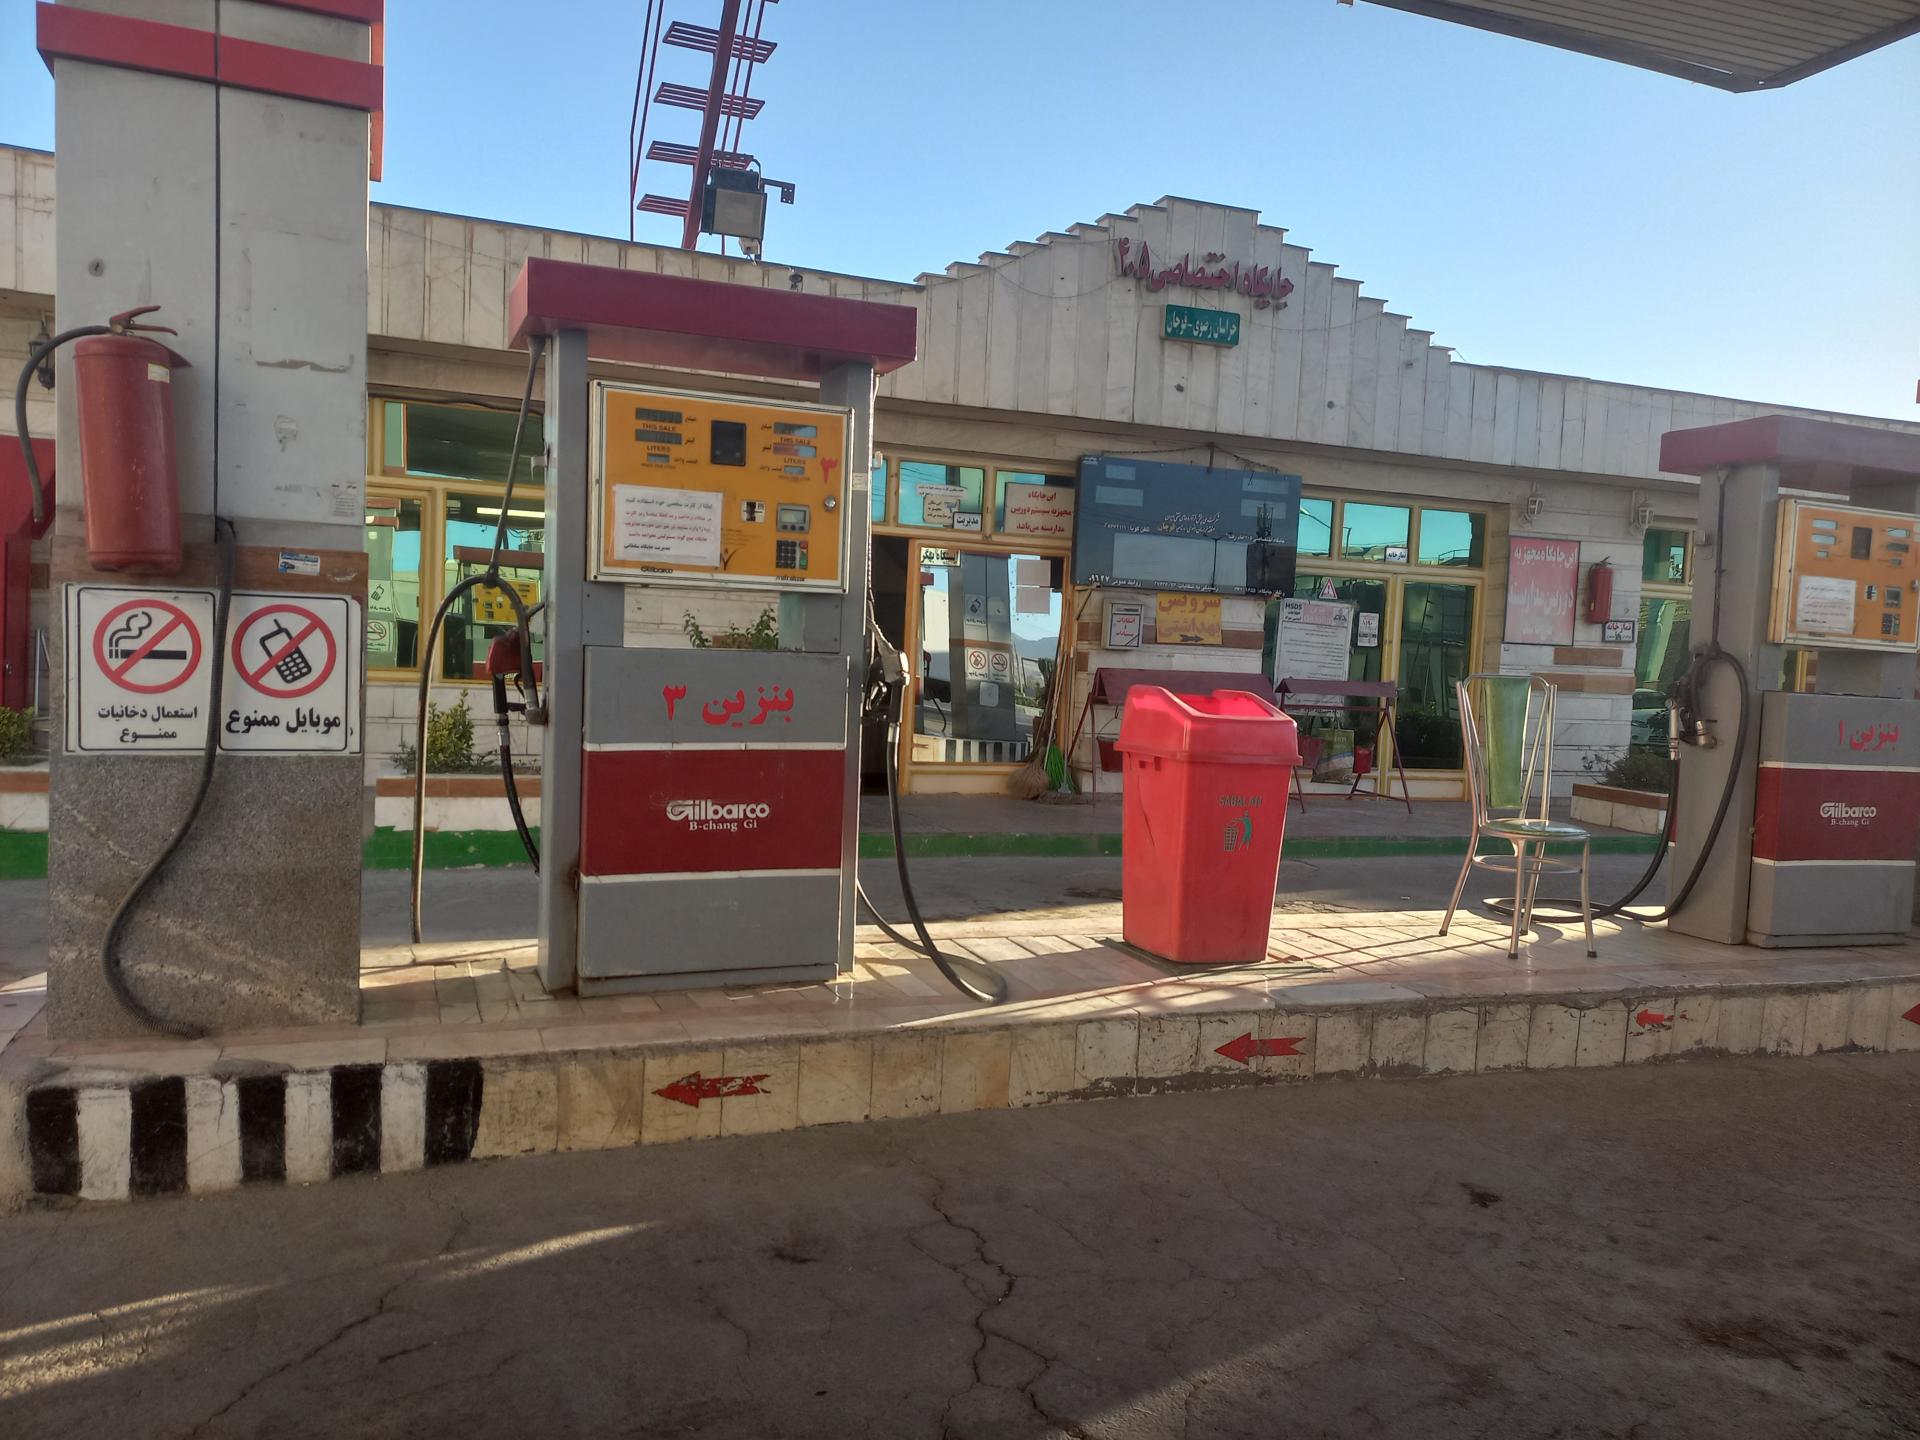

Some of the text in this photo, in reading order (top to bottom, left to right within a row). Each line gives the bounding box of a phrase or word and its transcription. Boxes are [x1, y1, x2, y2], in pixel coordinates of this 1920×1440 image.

[1241, 263, 1295, 310] جایگاه
[1166, 310, 1188, 336] قوچان
[1191, 318, 1213, 339] رضوی
[1212, 315, 1237, 342] خراسان
[1028, 490, 1057, 502] این جایگاه
[1010, 506, 1031, 515] دوربین
[956, 516, 979, 528] مدیریت
[1564, 547, 1579, 569] این
[1158, 595, 1221, 614] سرویس
[97, 705, 198, 723] استعمال دخانیات
[662, 683, 795, 729] بنزین ۳
[225, 706, 341, 735] موبایل ممنوع
[1849, 721, 1902, 753] بنزین
[666, 799, 771, 821] Gilbarco
[1820, 802, 1877, 818] Gilbarco
[689, 820, 738, 832] B-chang
[1830, 818, 1860, 828] B-chang
